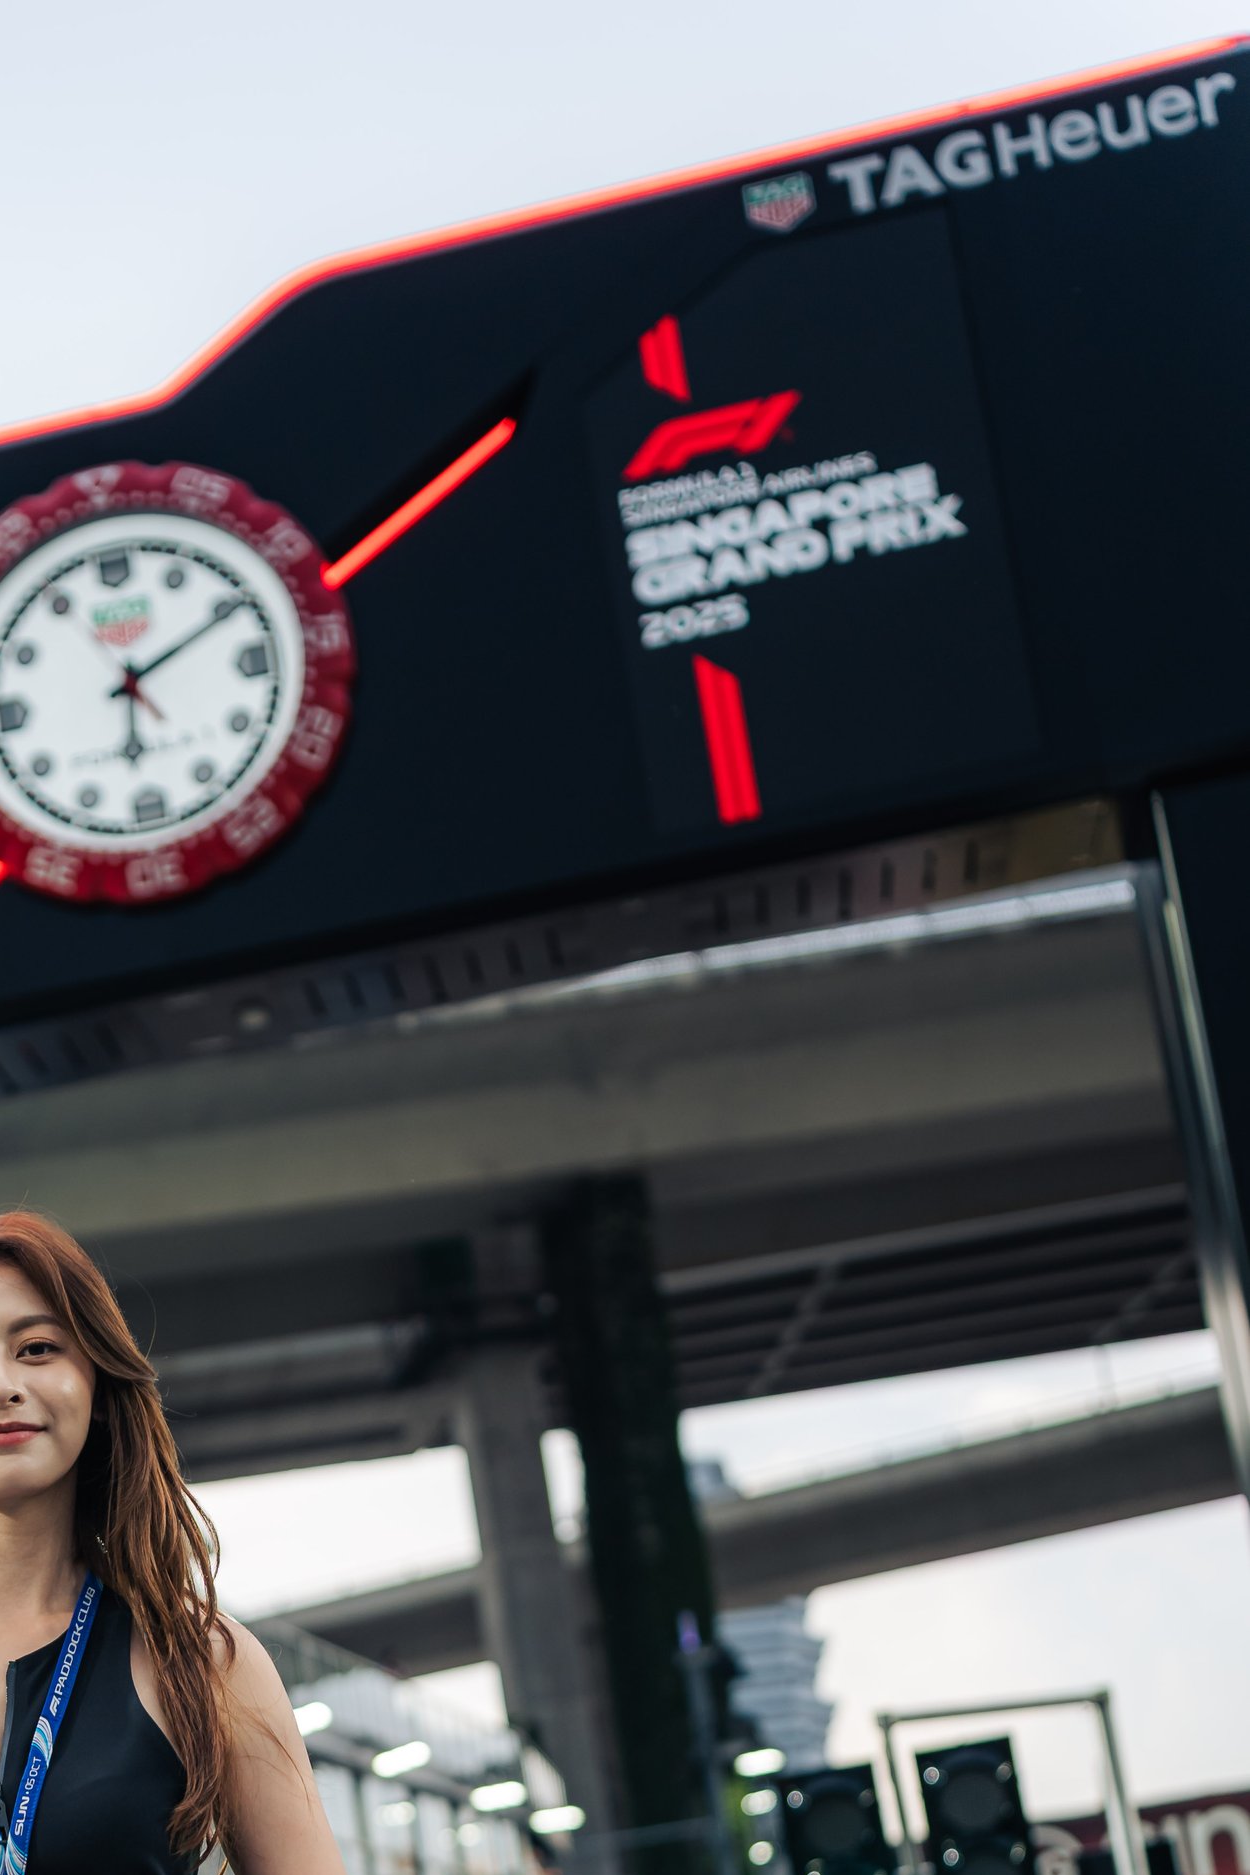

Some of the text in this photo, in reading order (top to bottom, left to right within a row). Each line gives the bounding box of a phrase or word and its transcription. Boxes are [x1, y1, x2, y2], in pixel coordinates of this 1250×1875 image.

[625, 462, 939, 572] SINGAPORE
[633, 493, 969, 606] GRAND PRIX
[639, 593, 749, 649] 2025
[54, 1623, 83, 1695] PADDOCK
[77, 1586, 96, 1623] CLUB
[28, 1756, 42, 1777] OCT
